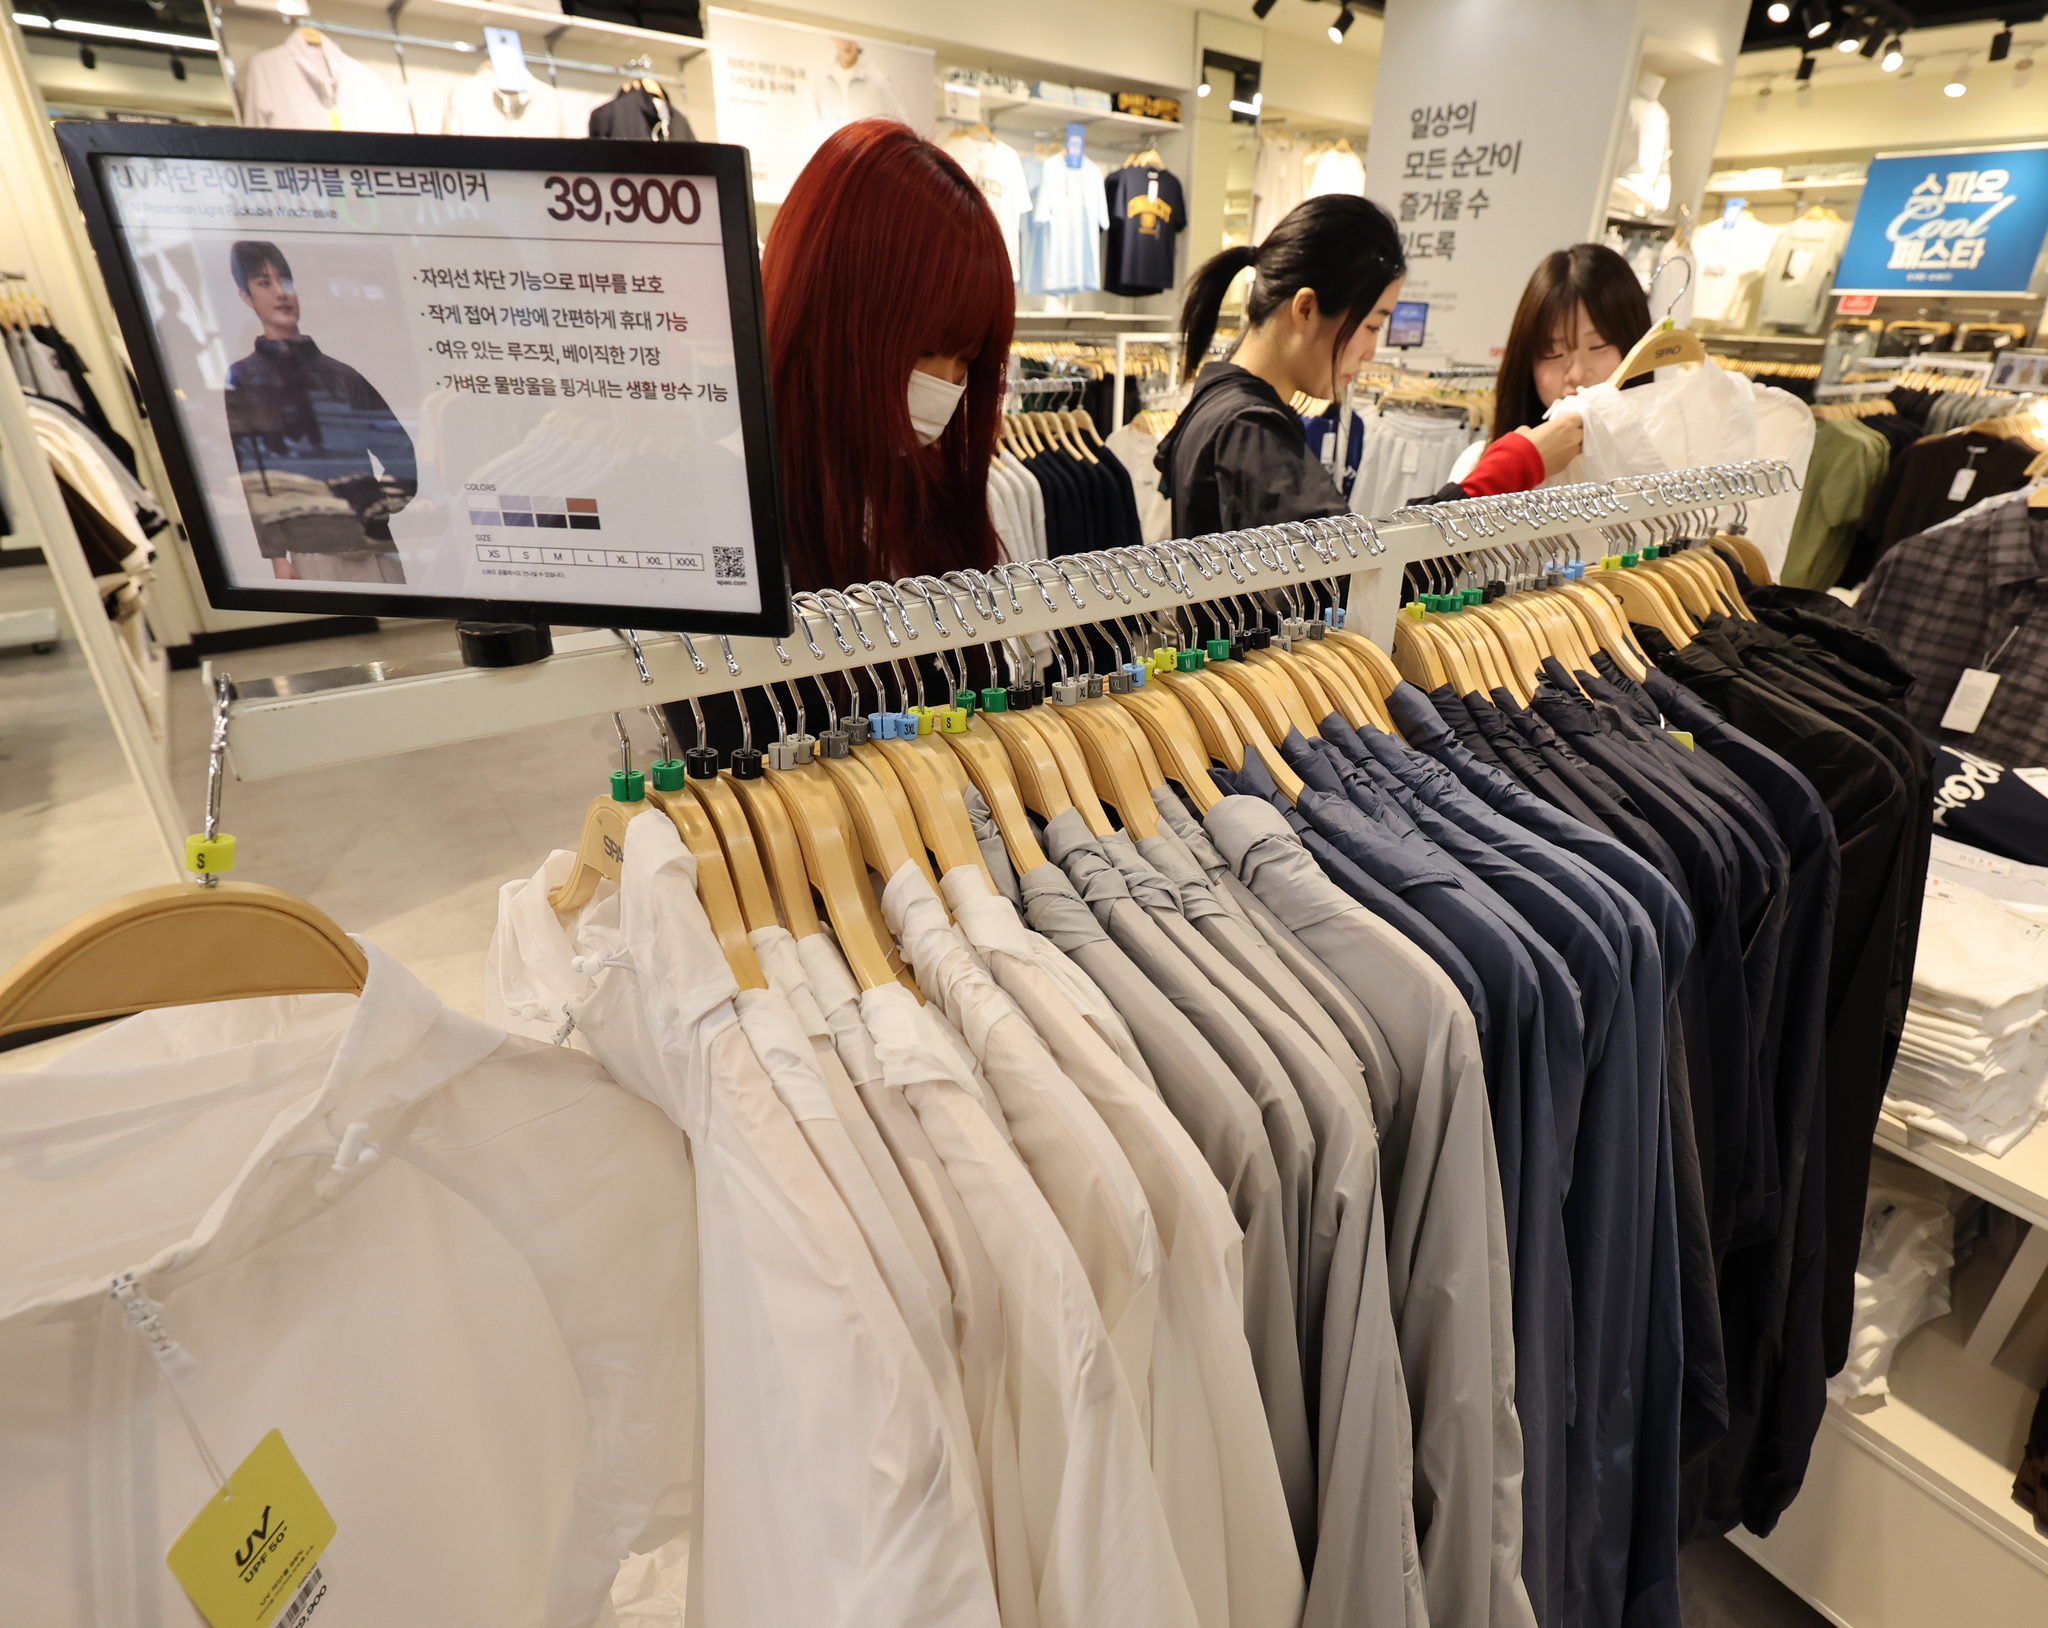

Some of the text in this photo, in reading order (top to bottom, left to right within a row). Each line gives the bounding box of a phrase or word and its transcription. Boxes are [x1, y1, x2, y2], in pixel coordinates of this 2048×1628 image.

[1411, 100, 1477, 139] 일상의
[1403, 139, 1522, 179] 모든 순간이
[200, 166, 272, 195] 라이트
[274, 166, 345, 198] 패커블
[350, 168, 490, 202] 윈드브레이커
[544, 175, 701, 226] 39,900
[1400, 187, 1490, 222] 즐거울 수
[1886, 194, 2017, 242] Cool
[1886, 237, 1987, 270] 페스타
[420, 268, 665, 294] 자외선 차단 기능으로 피부를 보호
[428, 304, 688, 333] 작게 접어 가방에 간편하게 휴대 가능
[436, 340, 661, 367] 여유 있는 루즈핏, 베이직한 기장
[445, 374, 728, 402] 가벼운 물방울을 튕겨내는 생활 방수 기능
[464, 483, 497, 492] COLORS
[475, 534, 492, 542] SIZE
[488, 550, 698, 567] XS S M L XL XXL XXXL
[716, 579, 748, 588] spao.com
[1055, 690, 1064, 703] XL
[904, 723, 916, 736] 3XL
[946, 717, 952, 729] S
[196, 852, 206, 870] S
[603, 834, 624, 863] SPA
[234, 1505, 272, 1567] UV
[244, 1551, 268, 1583] UPF
[294, 1584, 327, 1628] 9,900
